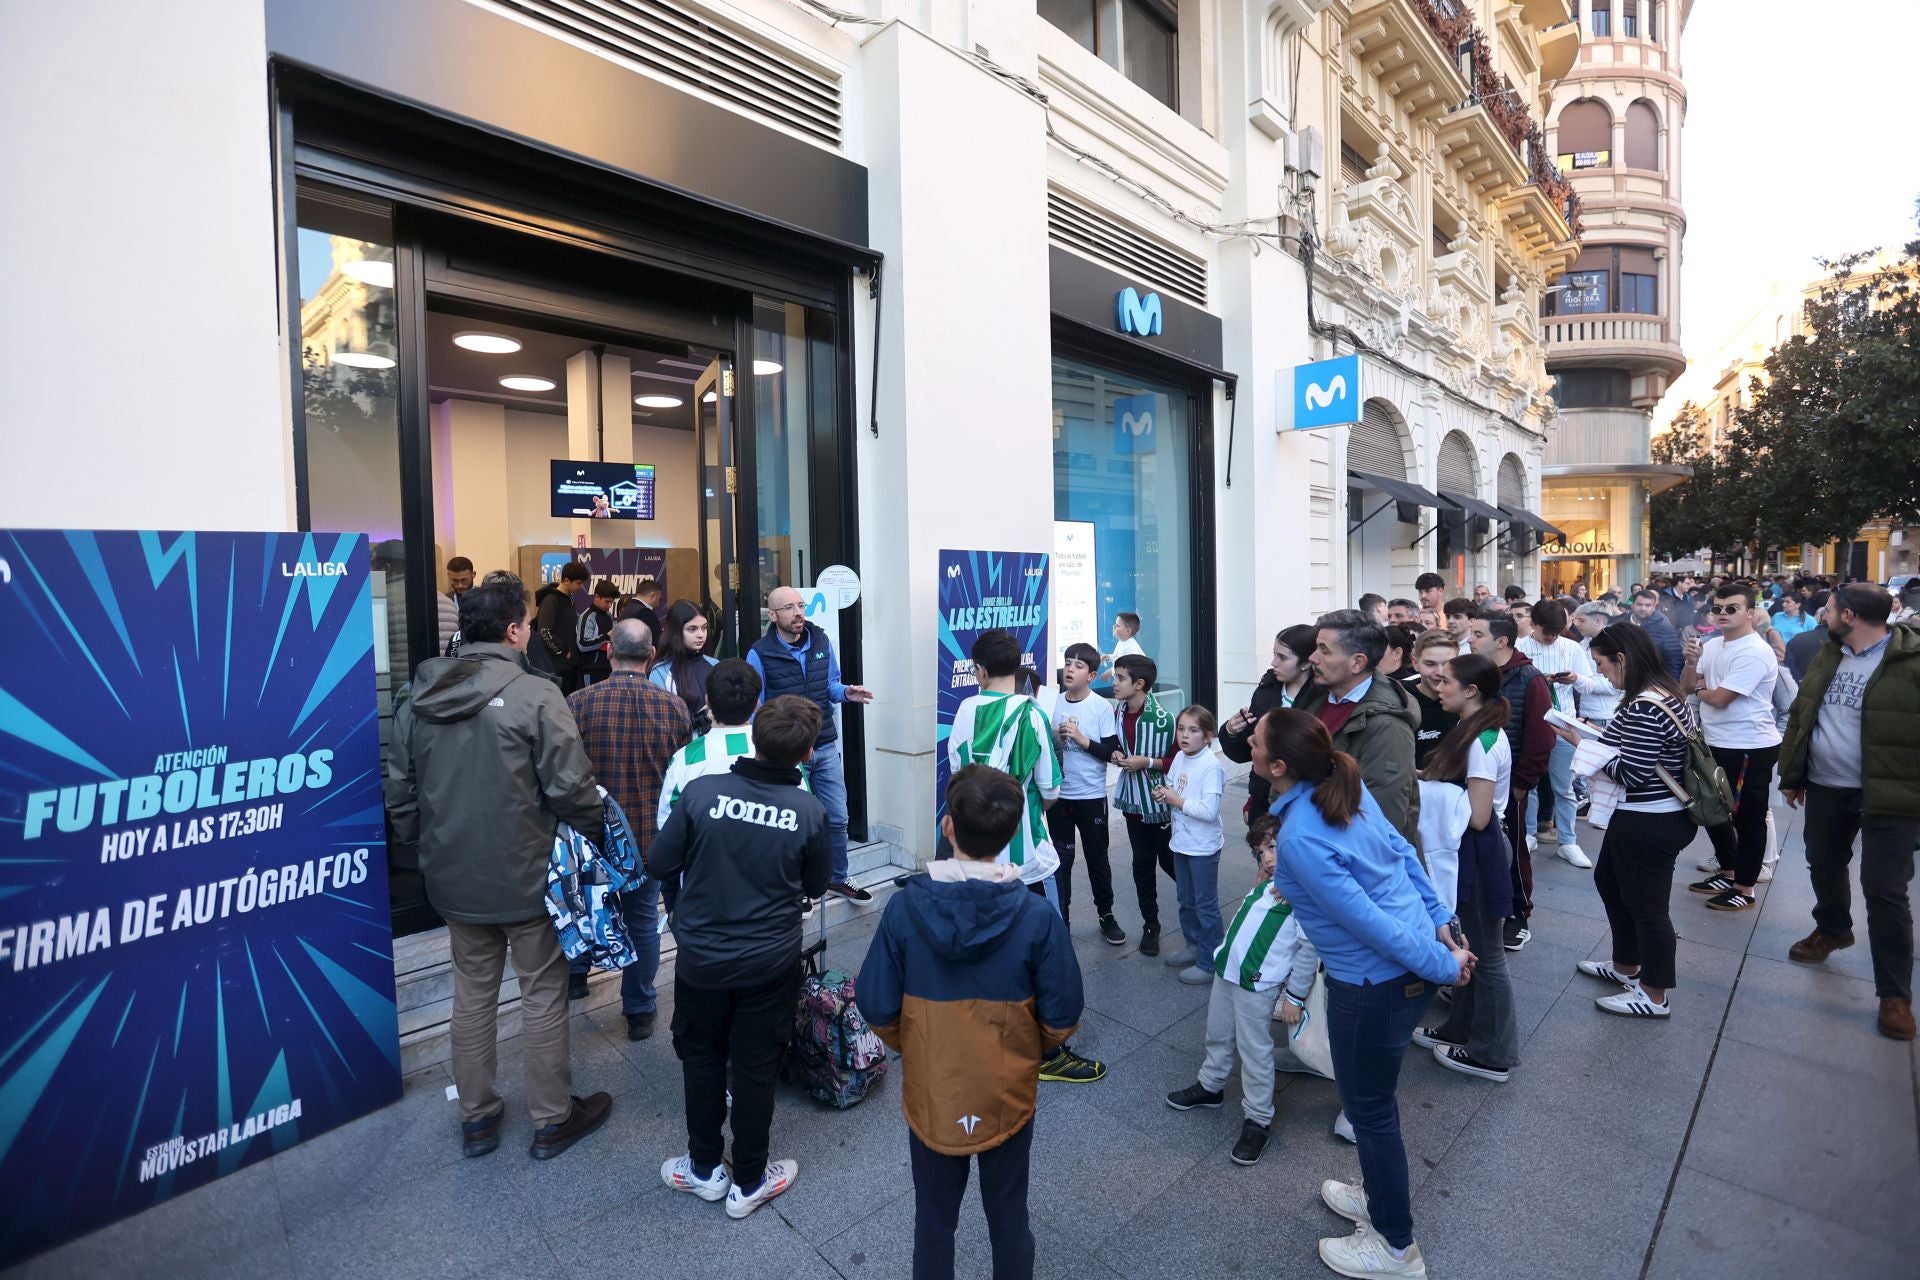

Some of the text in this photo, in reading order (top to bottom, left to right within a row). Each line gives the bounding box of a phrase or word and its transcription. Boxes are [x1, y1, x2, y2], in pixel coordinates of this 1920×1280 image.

[282, 562, 348, 577] LALIGA
[1024, 568, 1043, 576] LALIGA
[949, 605, 1041, 631] LAS ESTRELLAS
[154, 744, 228, 774] ATENCIÓN
[23, 748, 335, 841] FUTBOLEROS
[709, 795, 799, 831] Joma
[101, 803, 284, 864] HOY A LAS 17:30H
[119, 894, 168, 945] DE
[171, 847, 370, 933] AUTÓGRAFOS
[140, 1098, 302, 1183] MOVISTAR LALIGA
[146, 1136, 184, 1161] ESTADIO
